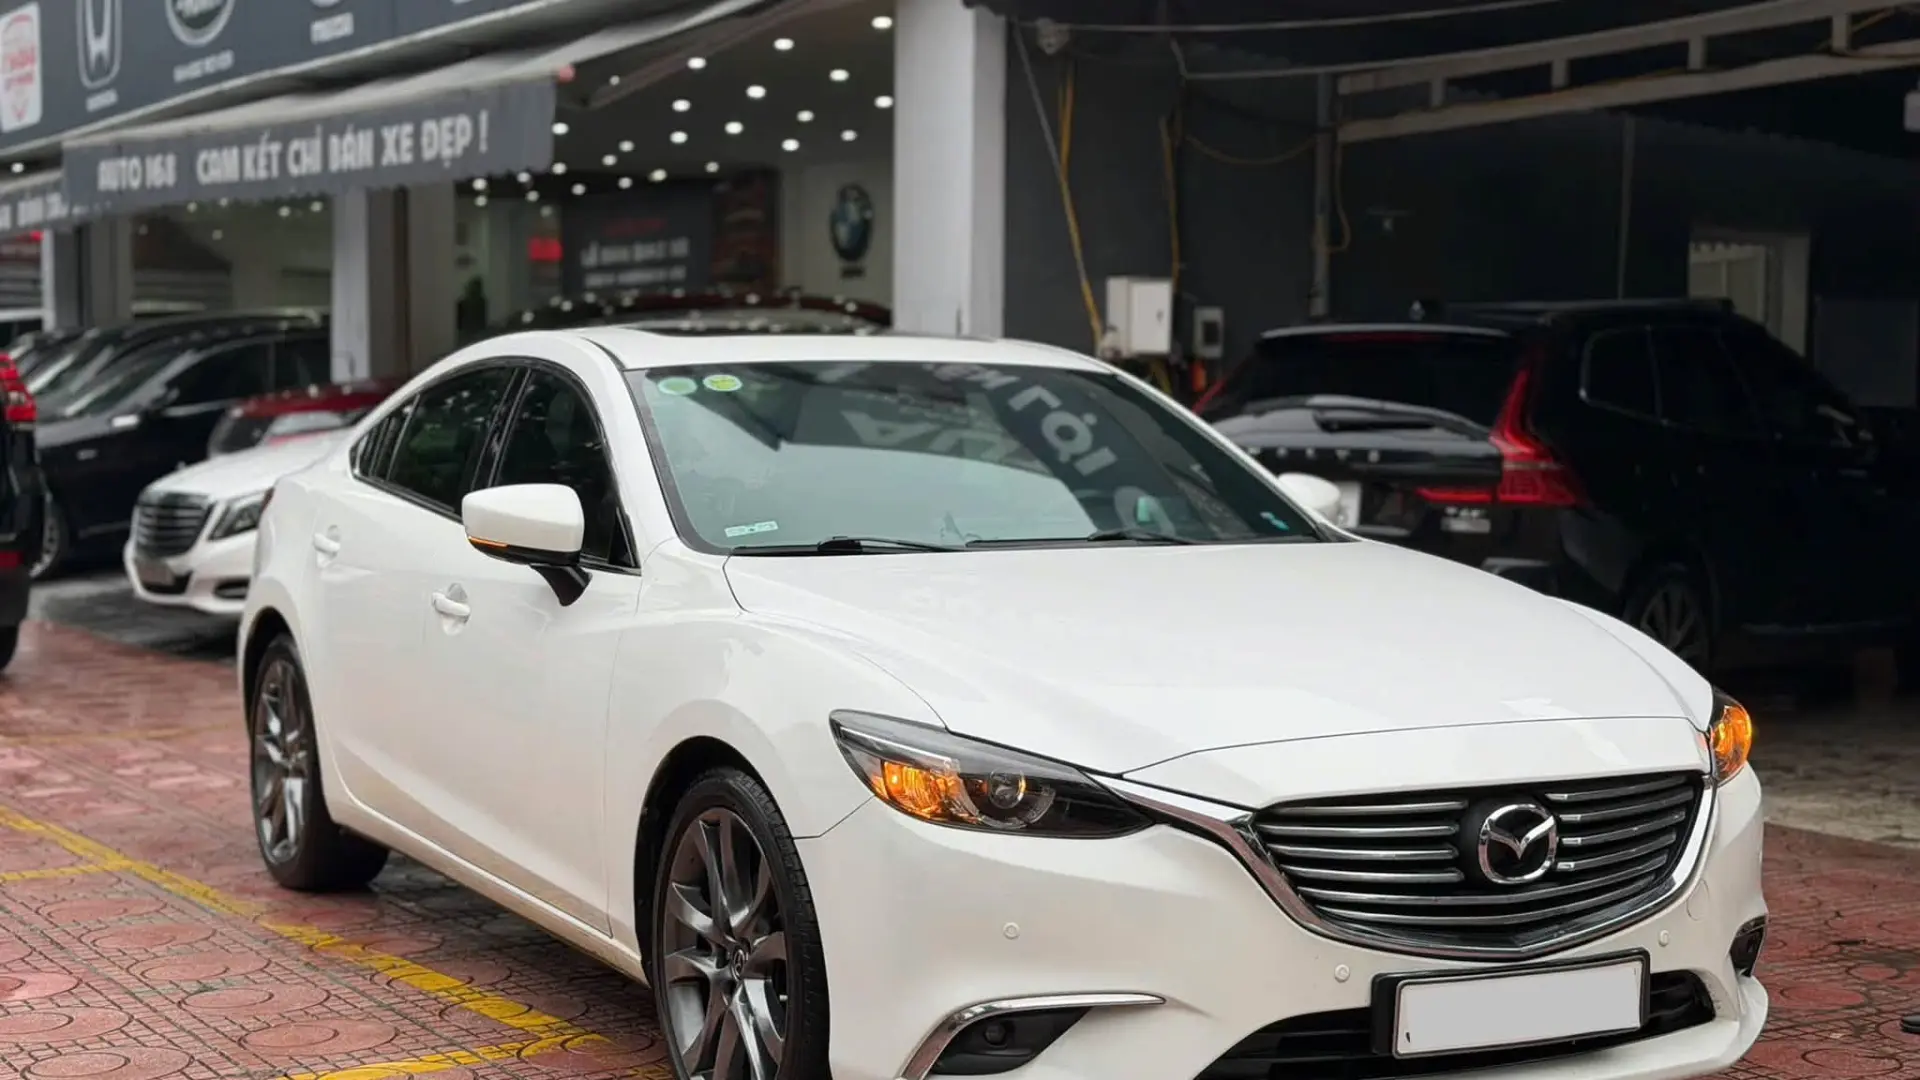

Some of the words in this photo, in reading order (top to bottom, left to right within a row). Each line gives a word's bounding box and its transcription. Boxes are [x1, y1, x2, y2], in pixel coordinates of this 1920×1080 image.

[98, 155, 142, 191] AUTO
[197, 145, 240, 185] CAM
[242, 129, 283, 181] KẾT
[287, 124, 322, 177] CHỈ
[328, 123, 374, 173] BÁN
[380, 122, 415, 167] XE
[420, 113, 473, 169] ĐẸP
[479, 109, 489, 154] !
